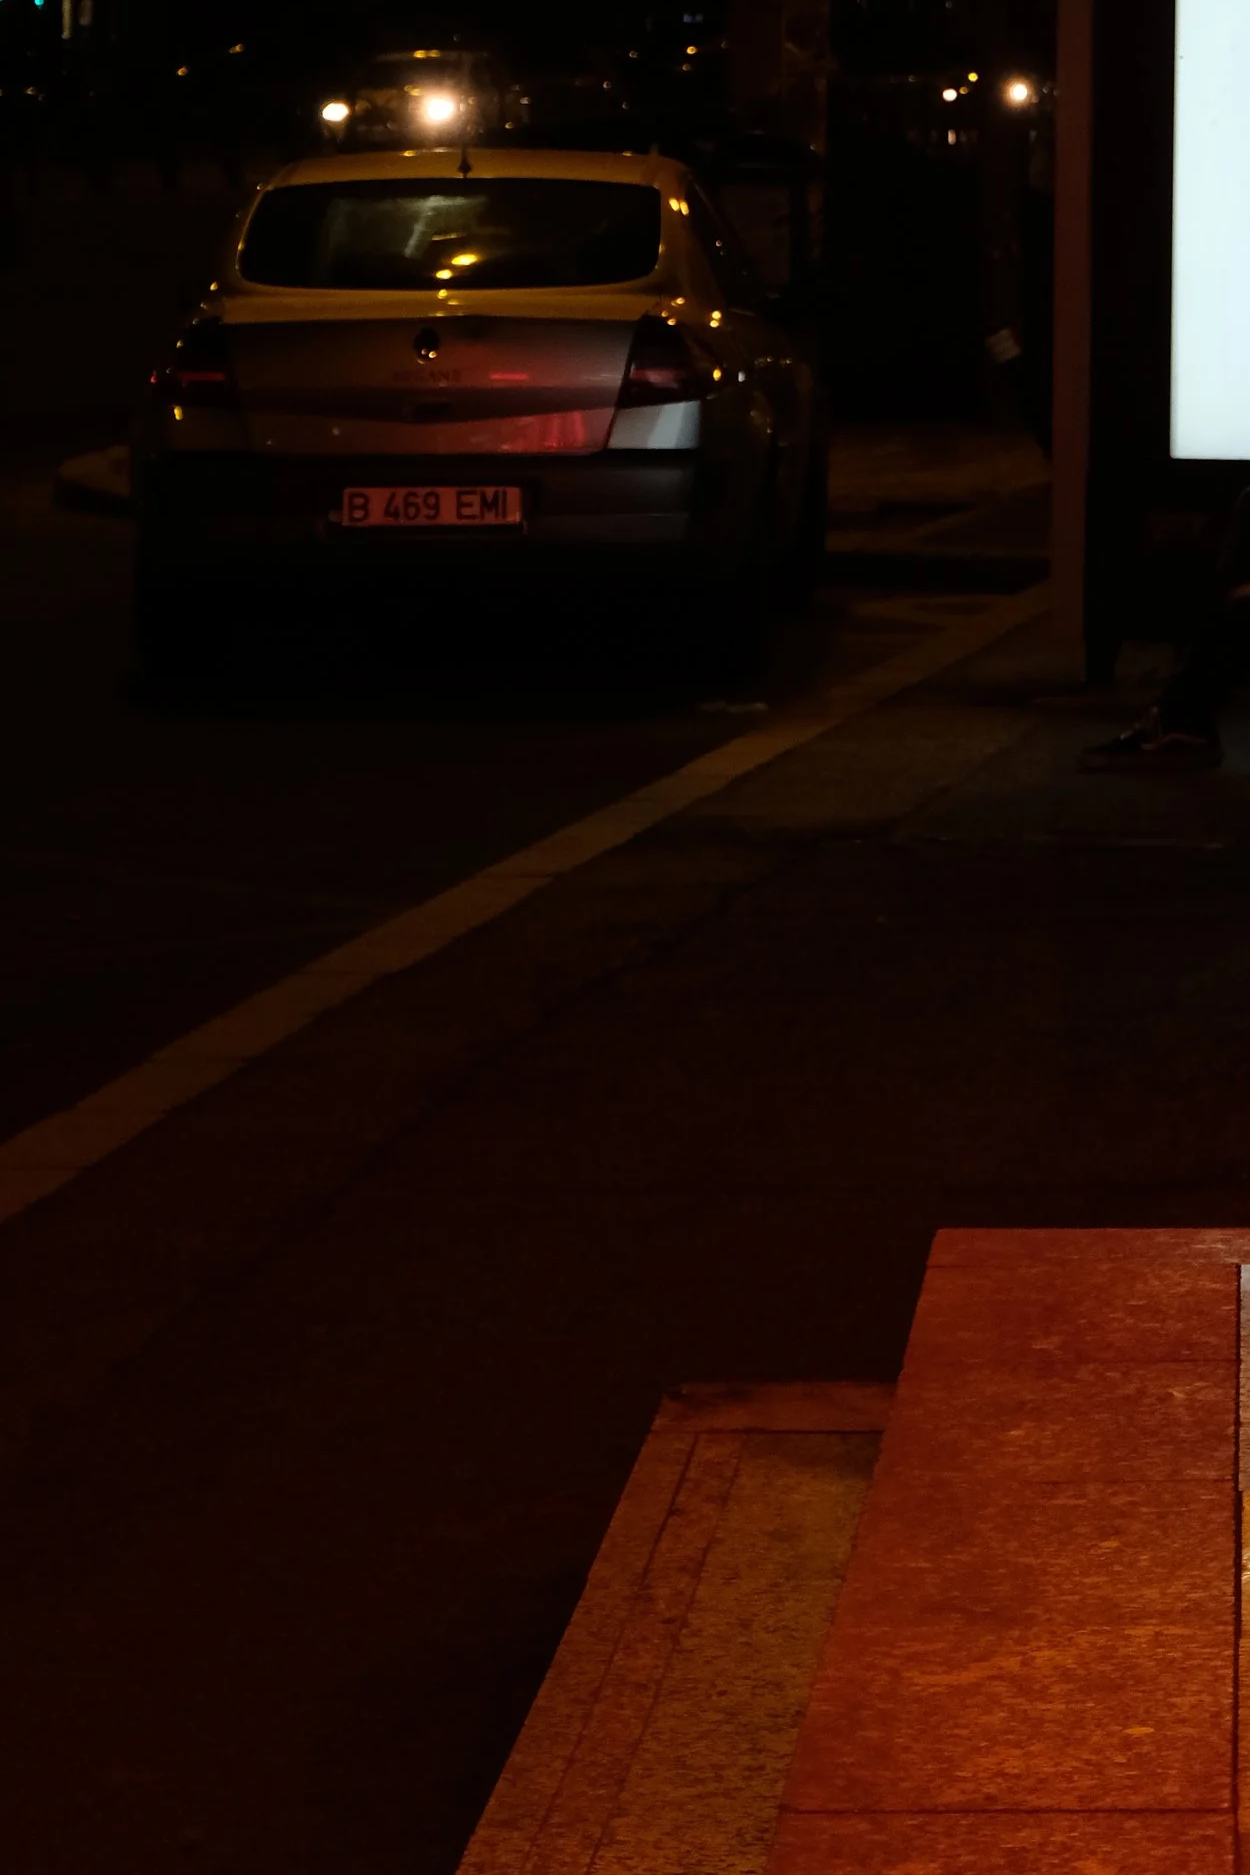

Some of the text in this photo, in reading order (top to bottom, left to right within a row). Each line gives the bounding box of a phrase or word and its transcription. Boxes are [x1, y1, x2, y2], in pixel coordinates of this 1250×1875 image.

[349, 489, 508, 523] B 469 EMI
